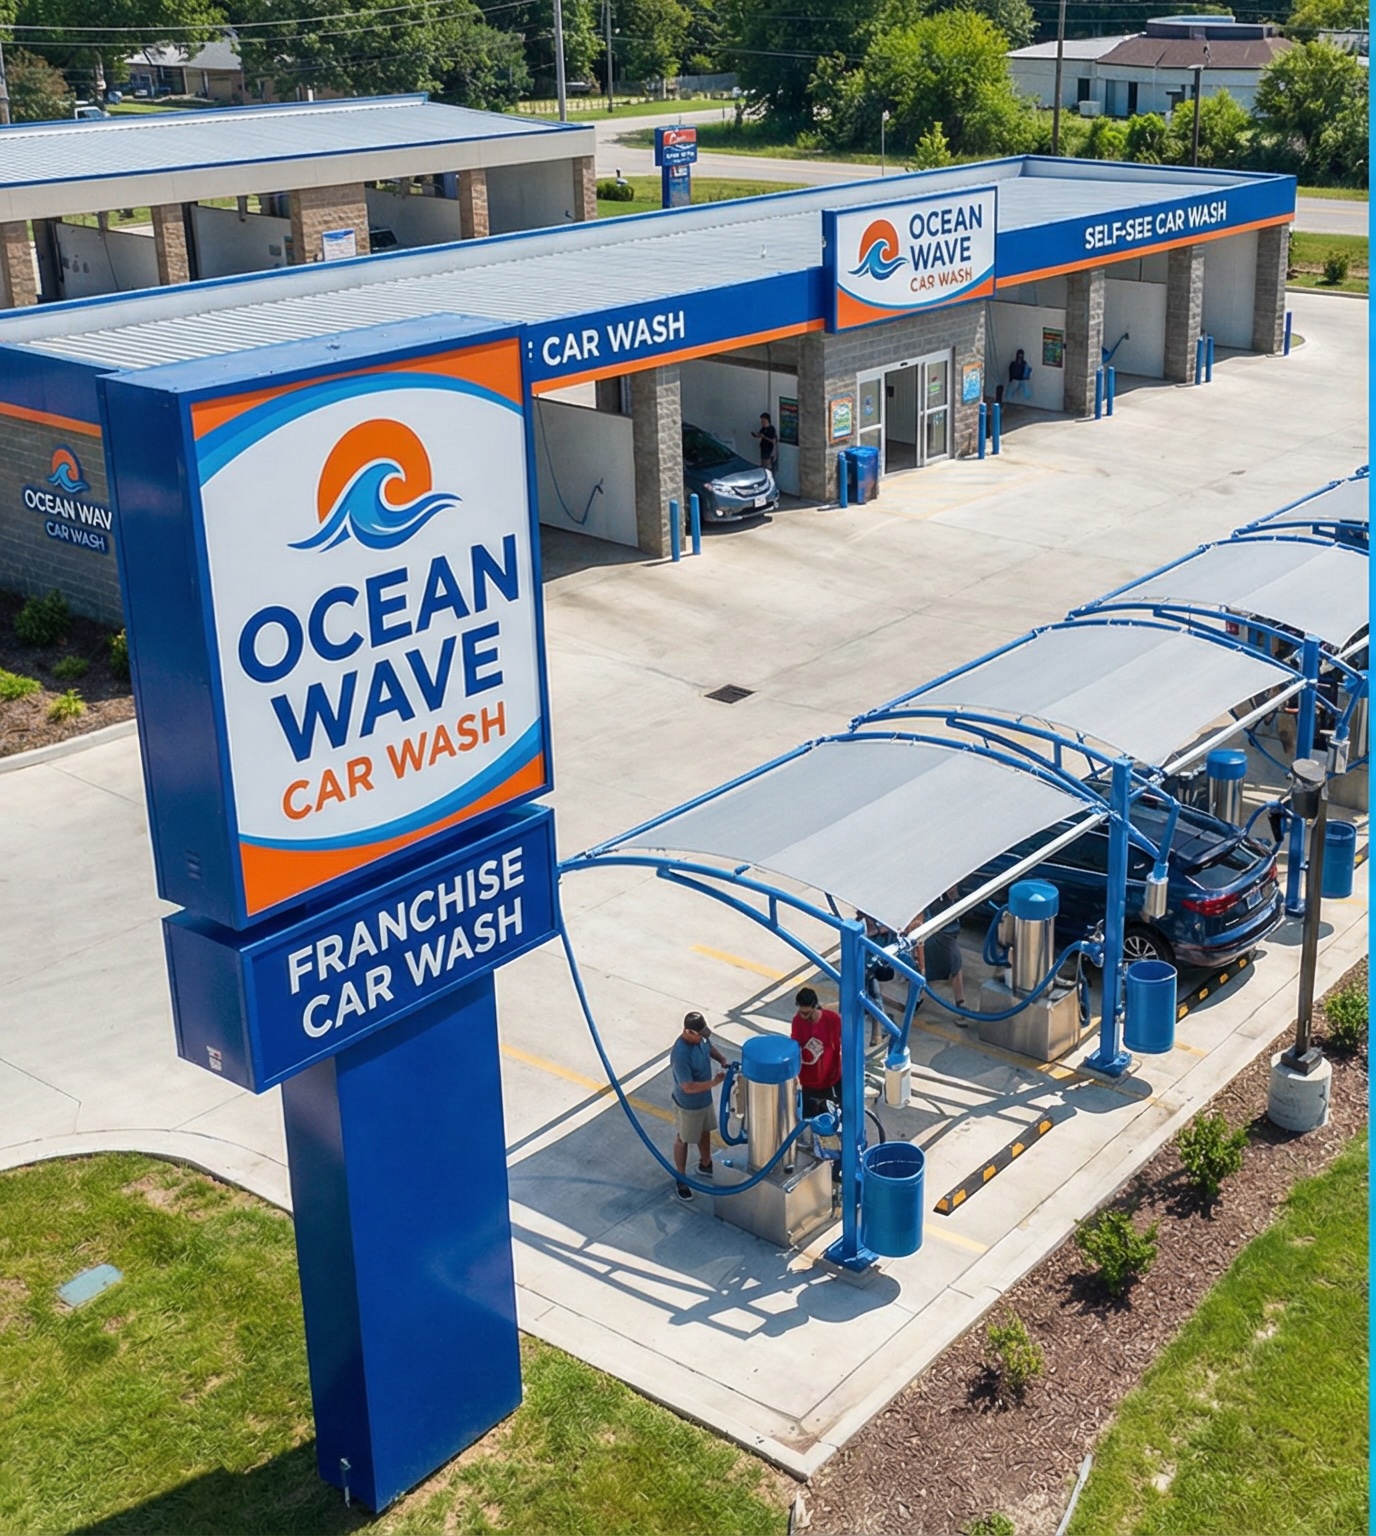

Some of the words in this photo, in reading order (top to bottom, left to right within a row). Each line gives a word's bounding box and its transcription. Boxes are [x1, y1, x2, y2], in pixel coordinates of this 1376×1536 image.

[909, 203, 982, 240] OCEAN
[1085, 216, 1153, 250] SELF-SEE
[1155, 209, 1185, 235] CAR
[1187, 200, 1227, 228] WASH
[909, 235, 972, 272] WAVE
[910, 274, 935, 292] CAR
[938, 266, 972, 287] WASH
[542, 329, 600, 366] CAR
[606, 310, 685, 352] WASH
[24, 489, 76, 521] OCEAN
[76, 501, 112, 530] WAV
[46, 521, 69, 541] CAR
[70, 527, 105, 551] WASH
[238, 533, 520, 684] OCEAN
[270, 620, 504, 763] WAVE
[282, 756, 374, 820] CAR
[386, 701, 506, 780] WASH
[288, 846, 525, 995] FRANCHISE
[302, 964, 395, 1038] CAR
[403, 896, 523, 987] WASH
